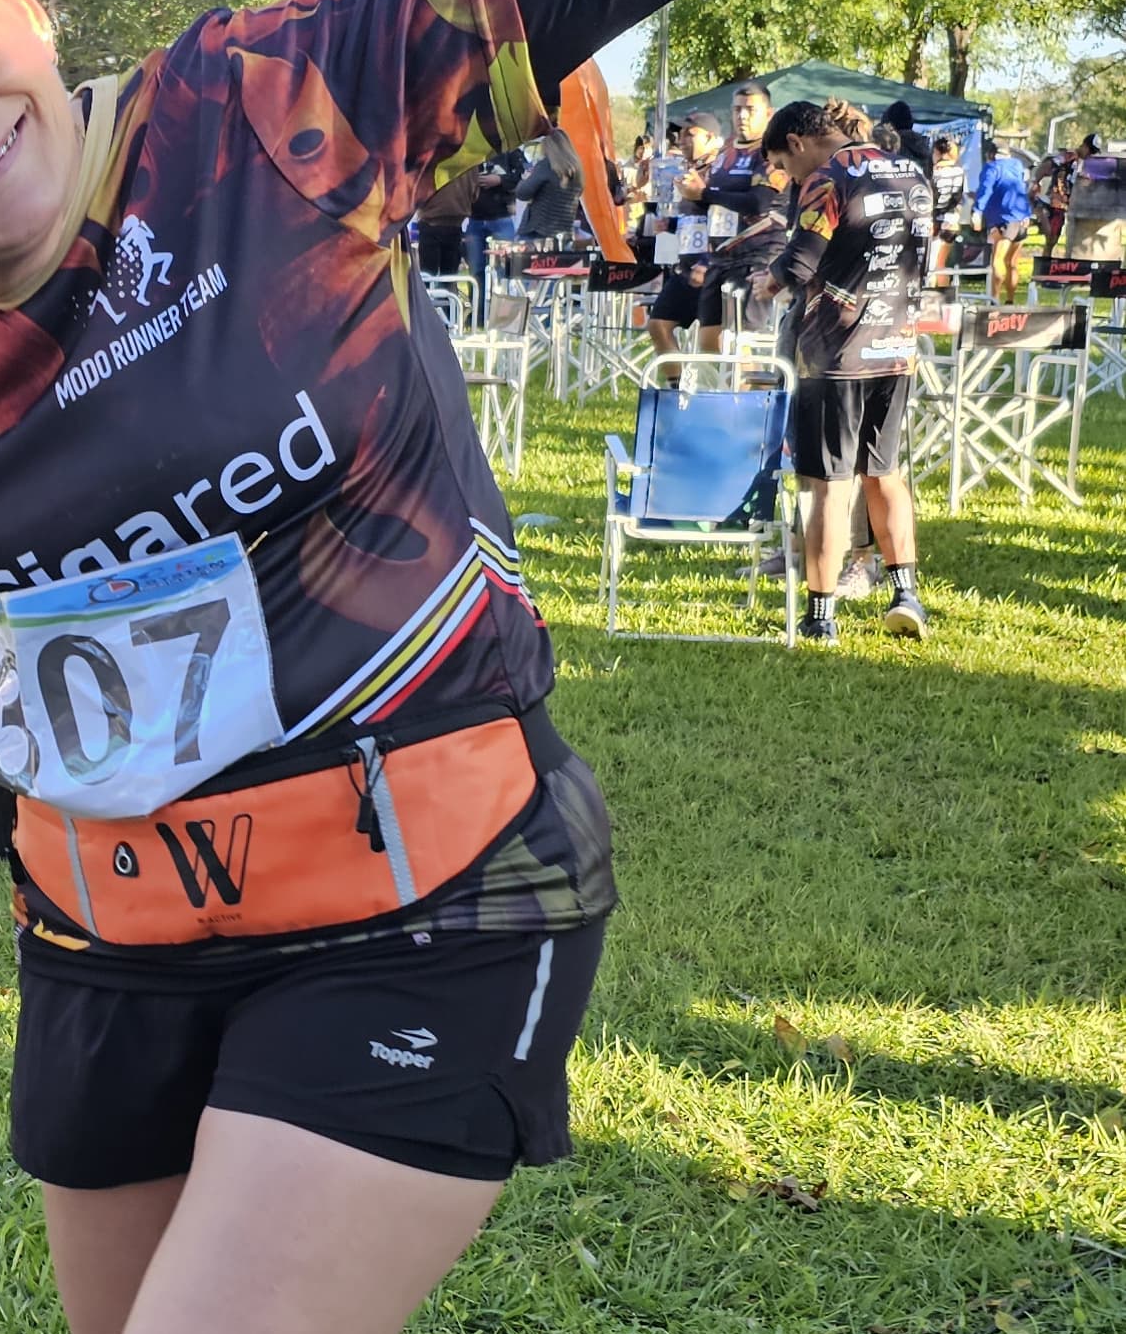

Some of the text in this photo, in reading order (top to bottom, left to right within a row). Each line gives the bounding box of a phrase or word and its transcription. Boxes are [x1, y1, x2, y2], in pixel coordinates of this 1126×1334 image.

[54, 263, 228, 410] MODO RUNNER TEAM
[986, 313, 1029, 337] paty
[155, 813, 253, 909] W
[369, 1040, 435, 1070] Topper
